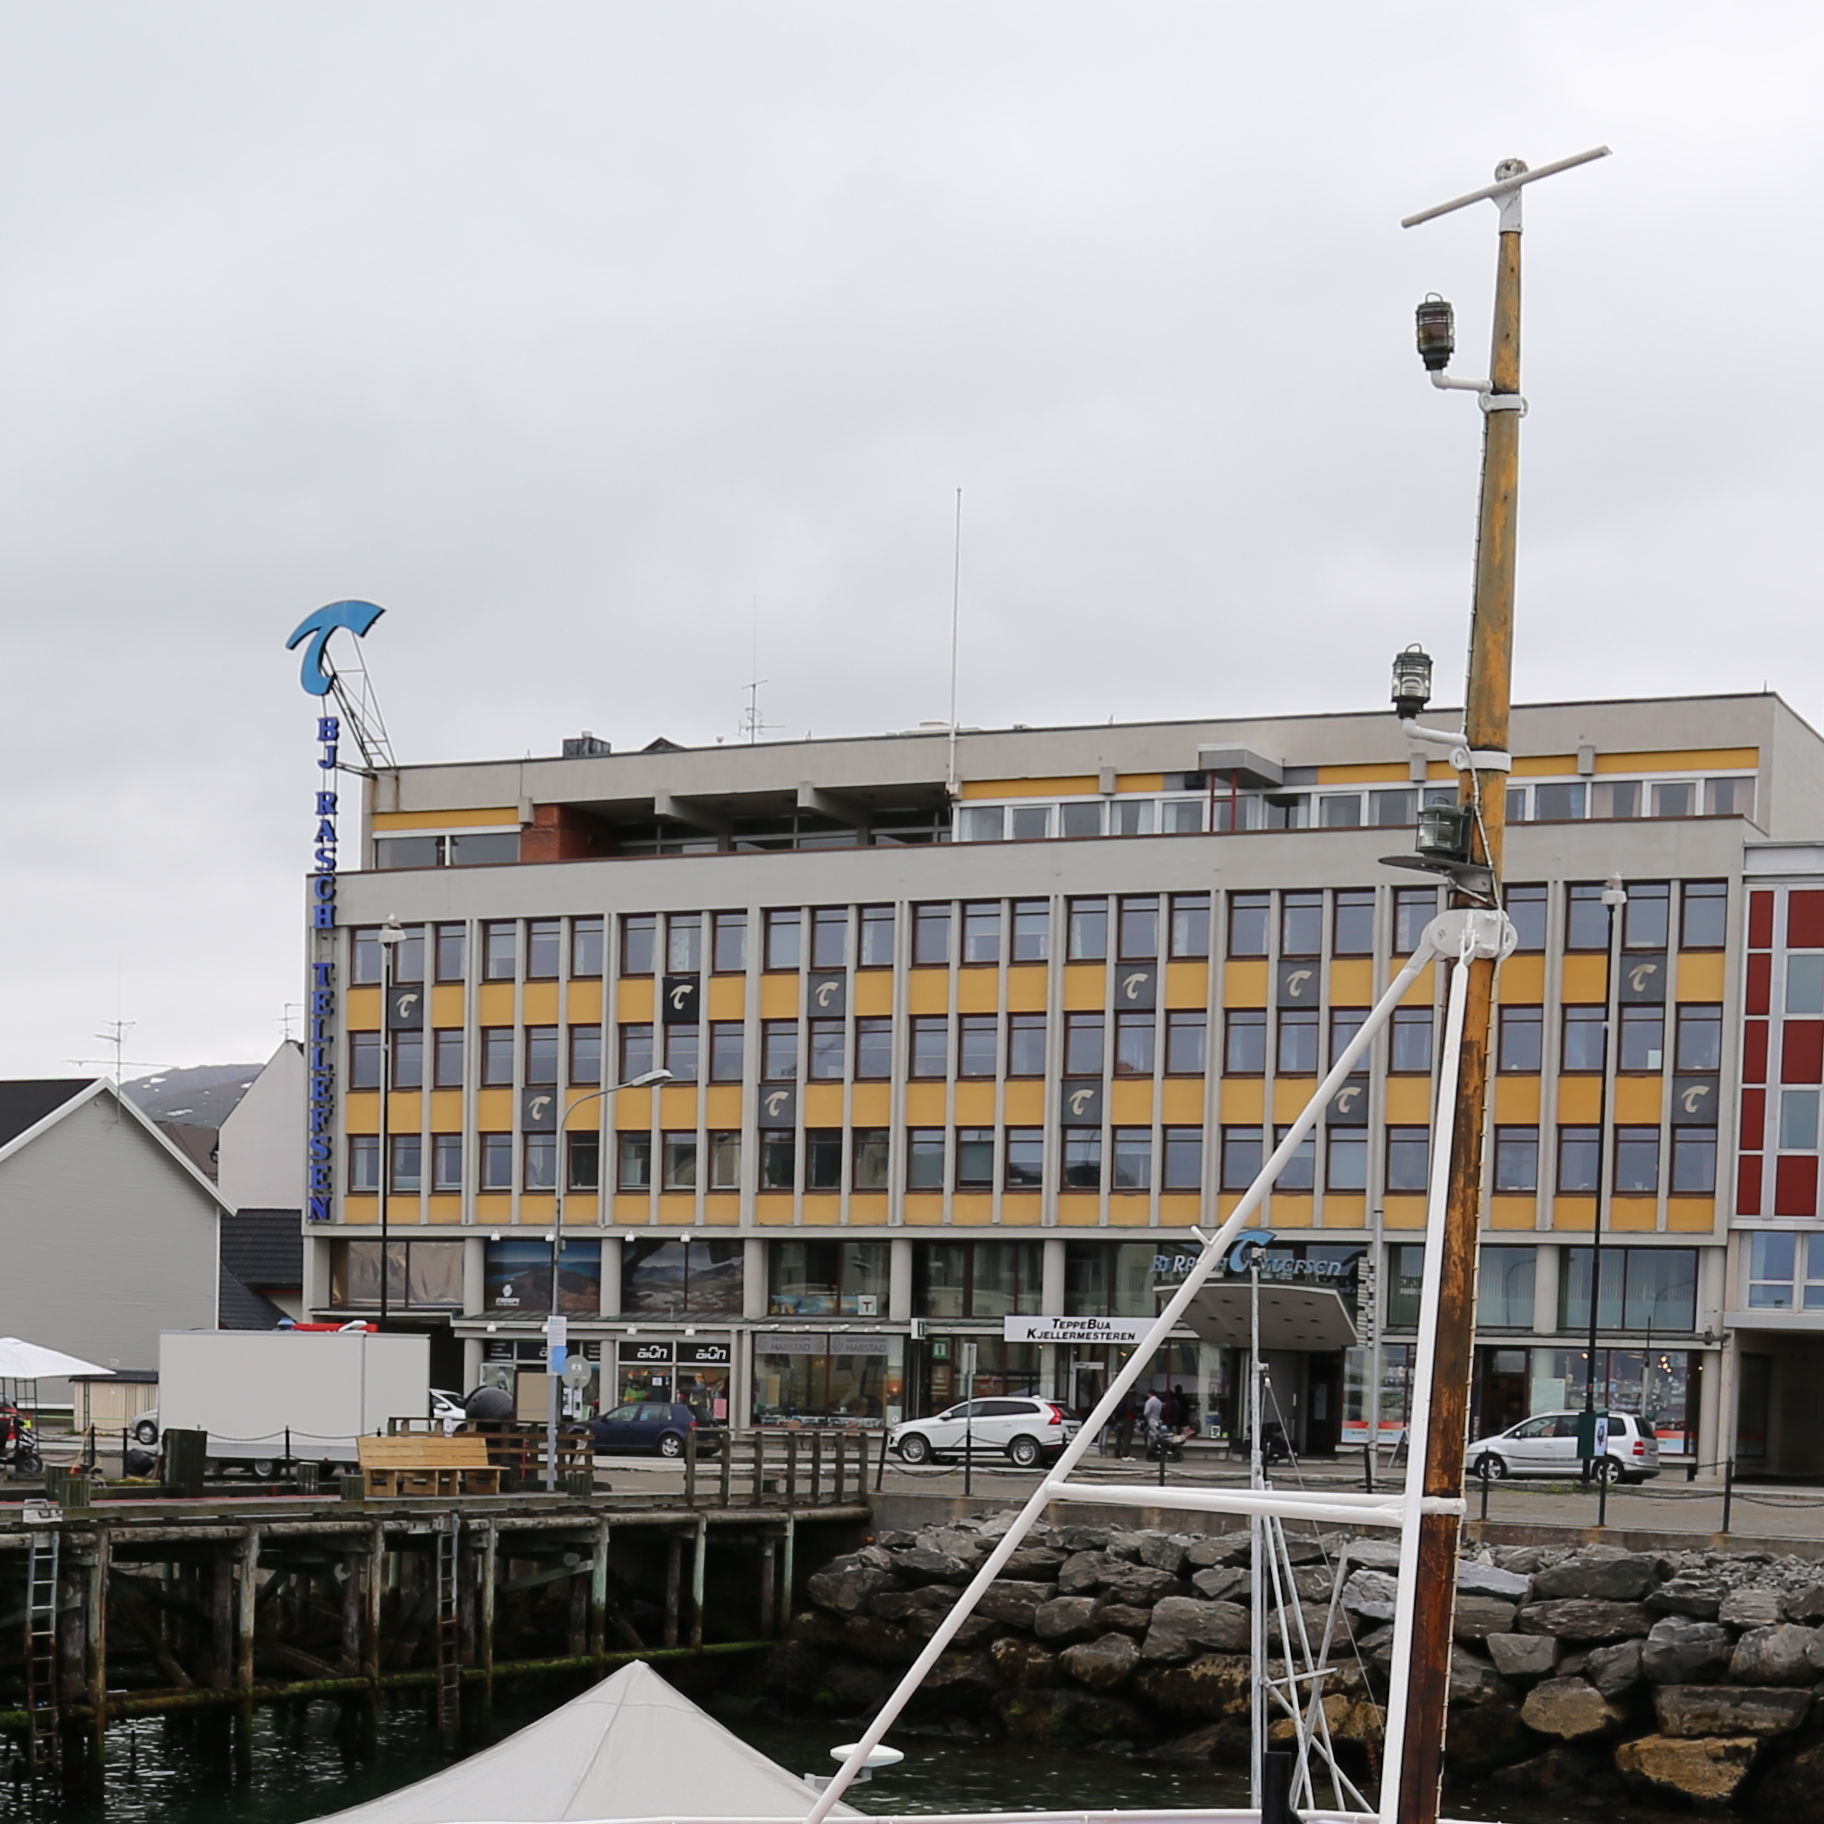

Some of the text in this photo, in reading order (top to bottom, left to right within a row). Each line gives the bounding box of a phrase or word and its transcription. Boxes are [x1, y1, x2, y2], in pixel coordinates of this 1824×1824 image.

[313, 790, 340, 931] RASCH
[308, 961, 337, 1222] TELLEFSEN
[771, 1341, 811, 1351] HARSTAD
[846, 1343, 886, 1353] HARSTAD
